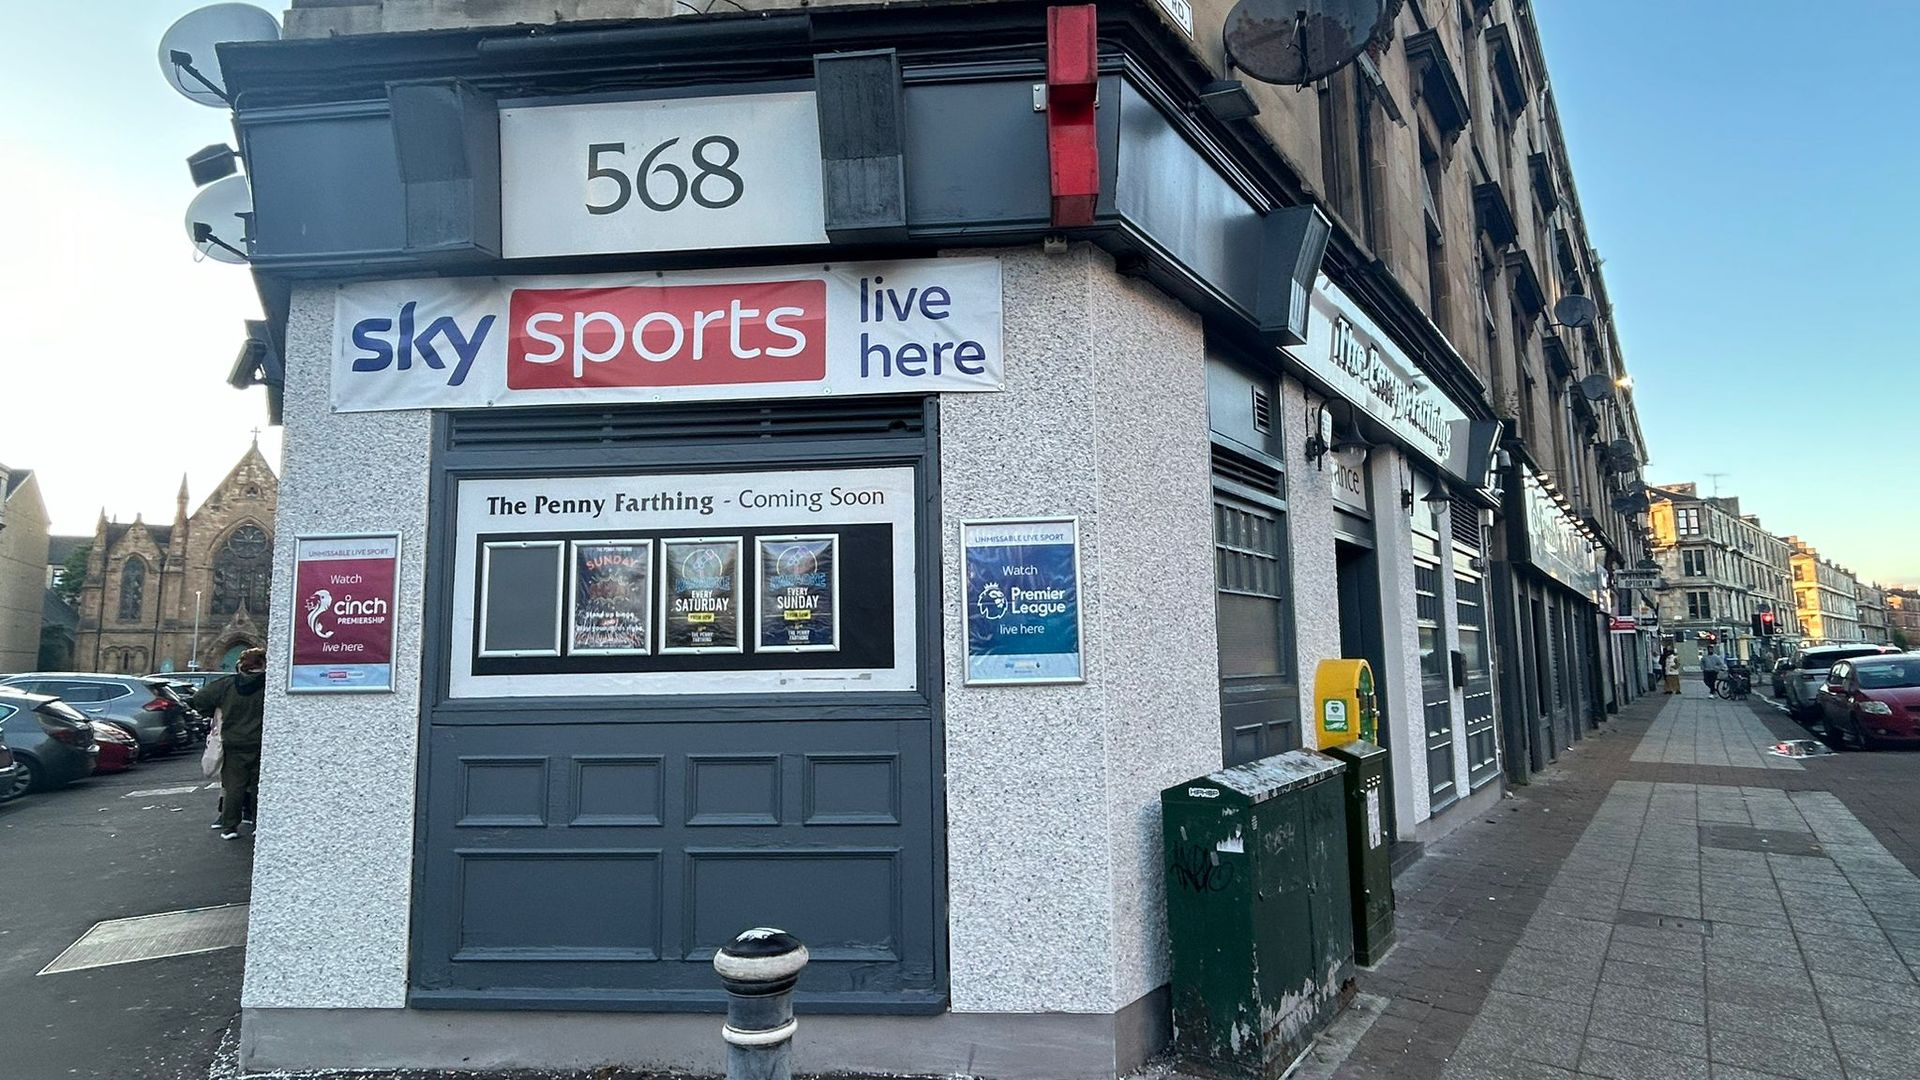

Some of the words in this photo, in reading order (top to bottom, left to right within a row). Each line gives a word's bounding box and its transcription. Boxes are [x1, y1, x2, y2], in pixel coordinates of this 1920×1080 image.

[586, 135, 744, 215] 568
[860, 276, 951, 322] live
[352, 301, 497, 386] sky
[524, 299, 807, 378] sports
[1330, 313, 1370, 386] The
[860, 332, 986, 378] here
[487, 496, 527, 515] The
[534, 495, 606, 518] Penny
[615, 491, 714, 515] Farthing
[739, 489, 823, 512] Coming
[830, 487, 885, 506] Soon
[974, 535, 1022, 543] UNMISSABLE
[1023, 534, 1038, 542] LIVE
[1040, 533, 1064, 541] SPORT
[586, 554, 640, 571] SUNDAY
[1003, 565, 1038, 576] Watch
[330, 574, 362, 584] Watch
[691, 590, 713, 599] EVERY
[787, 587, 808, 596] EVERY
[1011, 587, 1066, 601] Premier
[333, 595, 387, 615] cinch
[675, 598, 729, 612] SATURDAY
[777, 595, 820, 609] SUNDAY
[1011, 602, 1066, 616] League
[337, 616, 385, 624] PREMIERSHIP
[1000, 624, 1017, 635] live
[1020, 623, 1045, 634] here
[322, 642, 340, 652] live
[341, 642, 364, 652] here
